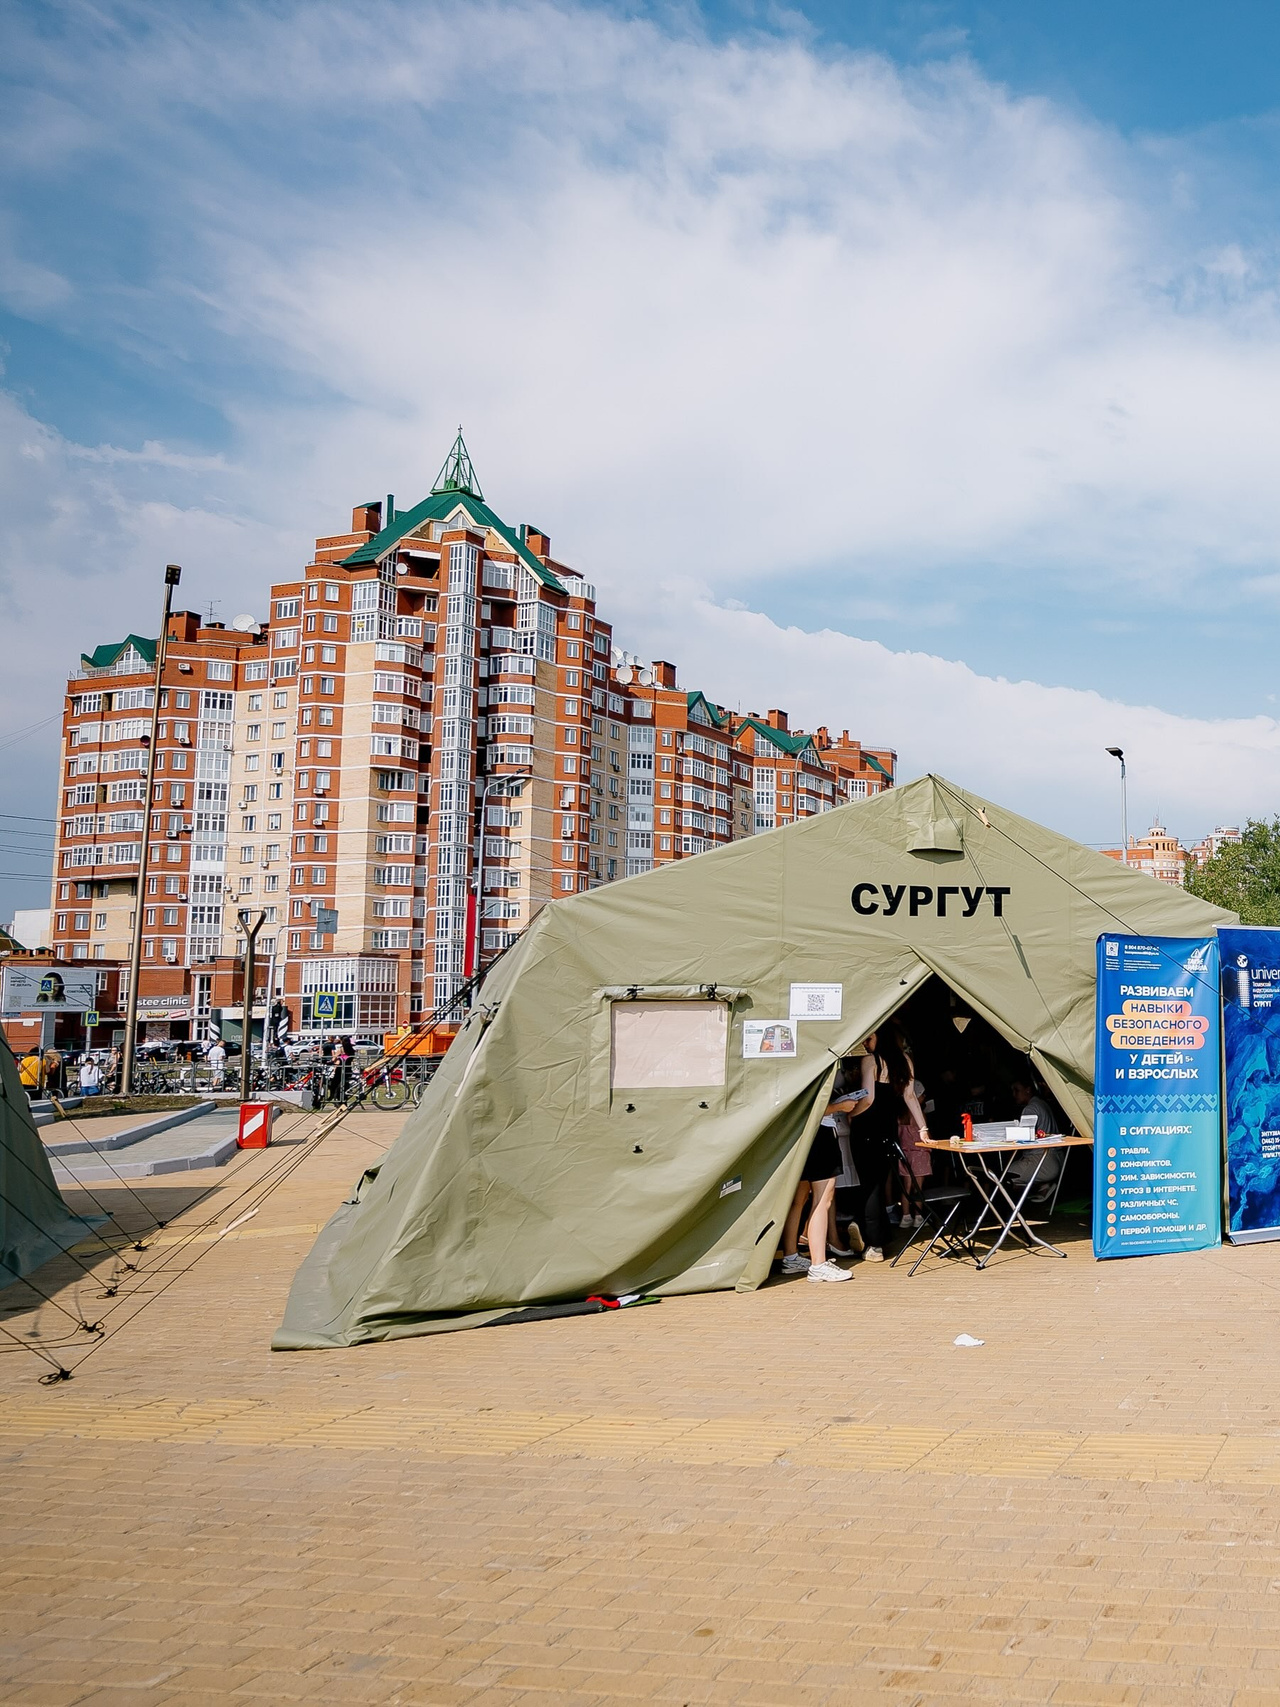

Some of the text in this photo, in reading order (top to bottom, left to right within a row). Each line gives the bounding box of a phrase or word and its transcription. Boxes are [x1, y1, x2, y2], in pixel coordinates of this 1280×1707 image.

[851, 882, 1011, 917] СУРГУТ
[1120, 985, 1194, 997] РАЗВИВАЕМ
[137, 996, 189, 1006] stee clinic
[1131, 1003, 1183, 1014] НАВЫКИ
[1113, 1019, 1202, 1030] БЕЗОПАСНОГО
[1120, 1035, 1195, 1047] ПОВЕДЕНИЯ
[1129, 1053, 1138, 1065] У
[1141, 1051, 1184, 1066] ДЕТЕЙ
[1115, 1068, 1199, 1080] И ВЗРОСЛЫХ
[1120, 1125, 1193, 1136] В СИТУАЦИЯХ:
[1120, 1147, 1151, 1155] ТРАВЛИ.
[1120, 1160, 1172, 1168] КОНФЛИКТОВ.
[1120, 1172, 1197, 1182] ХИМ. ЗАВИСИМОСТИ.
[1120, 1185, 1198, 1195] УГРОЗ В ИНТЕРНЕТЕ.
[1120, 1199, 1166, 1209] РАЗЛИЧНЫХ
[1120, 1212, 1180, 1222] САМООБОРОНЫ.
[1120, 1226, 1151, 1236] ПЕРВОЙ
[1152, 1224, 1187, 1234] ПОМОЩИ
[1188, 1223, 1195, 1231] И
